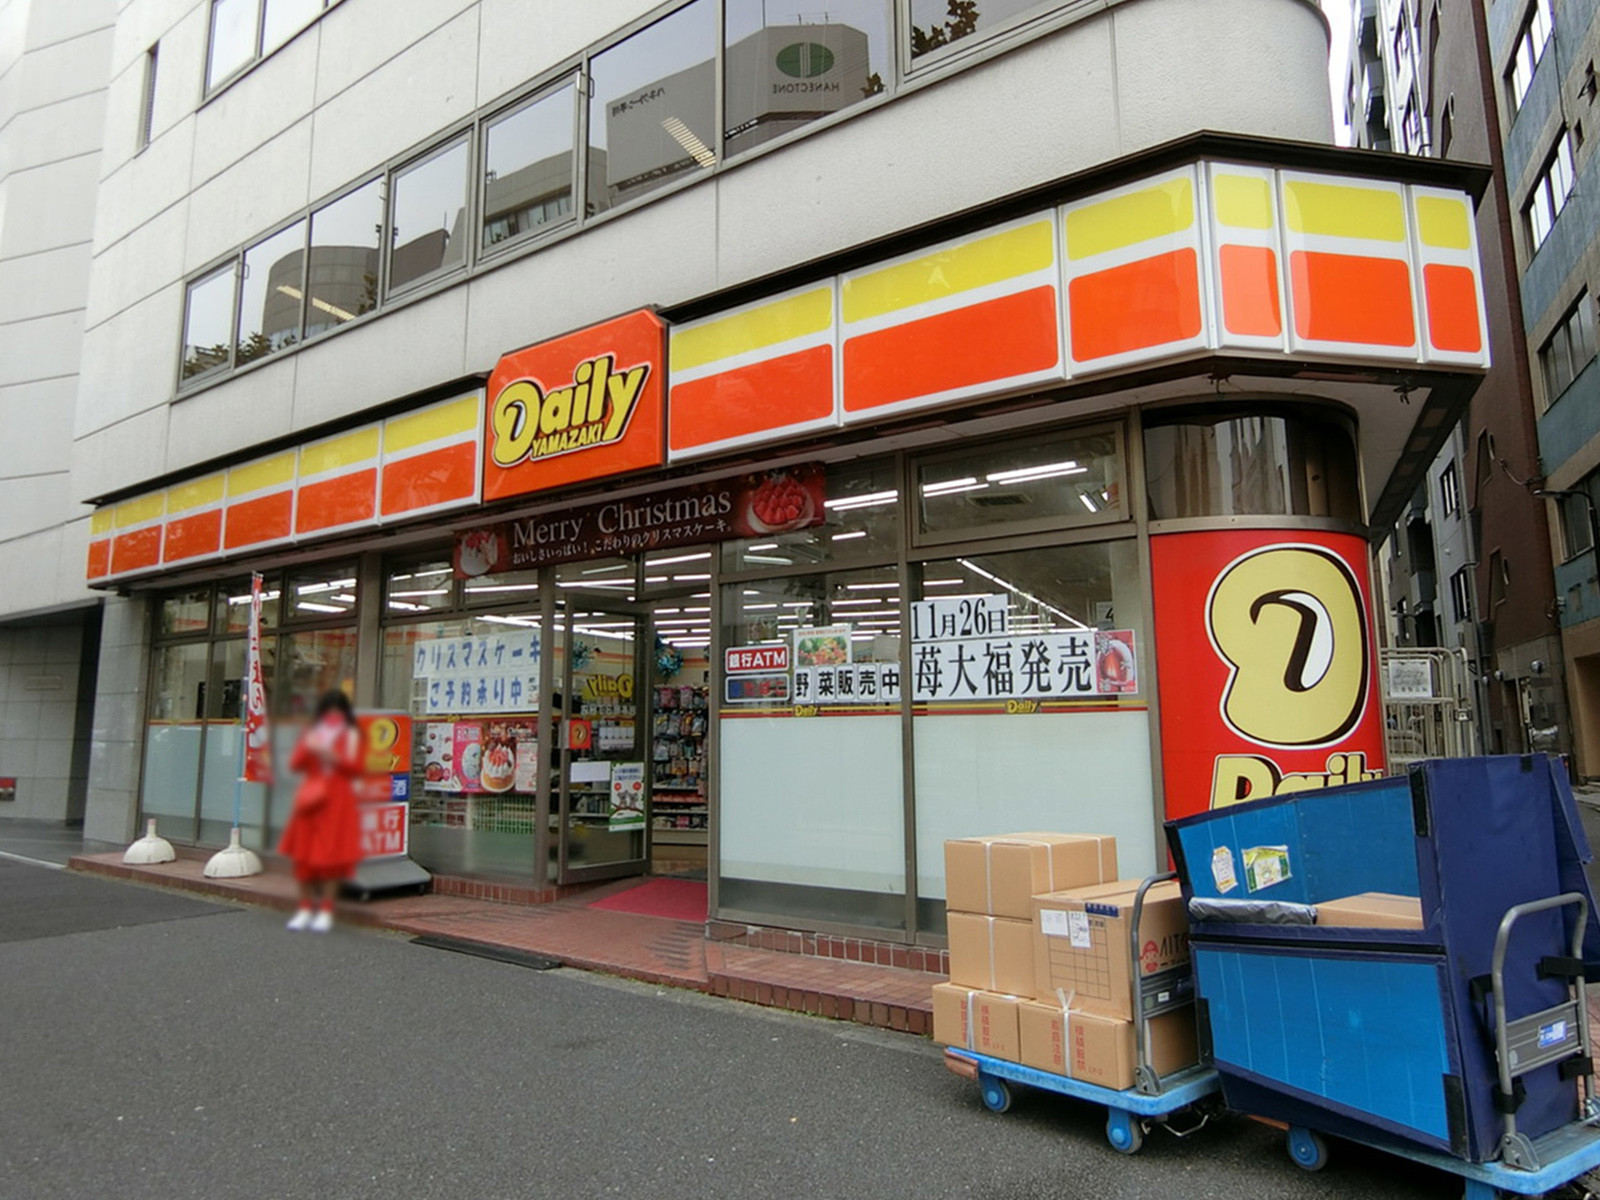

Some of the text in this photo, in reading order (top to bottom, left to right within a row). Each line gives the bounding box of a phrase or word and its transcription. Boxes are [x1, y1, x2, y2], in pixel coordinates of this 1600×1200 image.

[493, 352, 651, 466] Daily
[531, 422, 606, 458] YAMAZAKI
[513, 491, 732, 548] Merry Christmas
[912, 598, 1005, 639] 11月26日
[416, 634, 540, 670] クリスマスケーキ
[729, 650, 785, 668] 銀行ATM
[914, 636, 1092, 697] 苺大福発売
[795, 669, 900, 697] 野菜販売中
[1007, 700, 1038, 714] Daily
